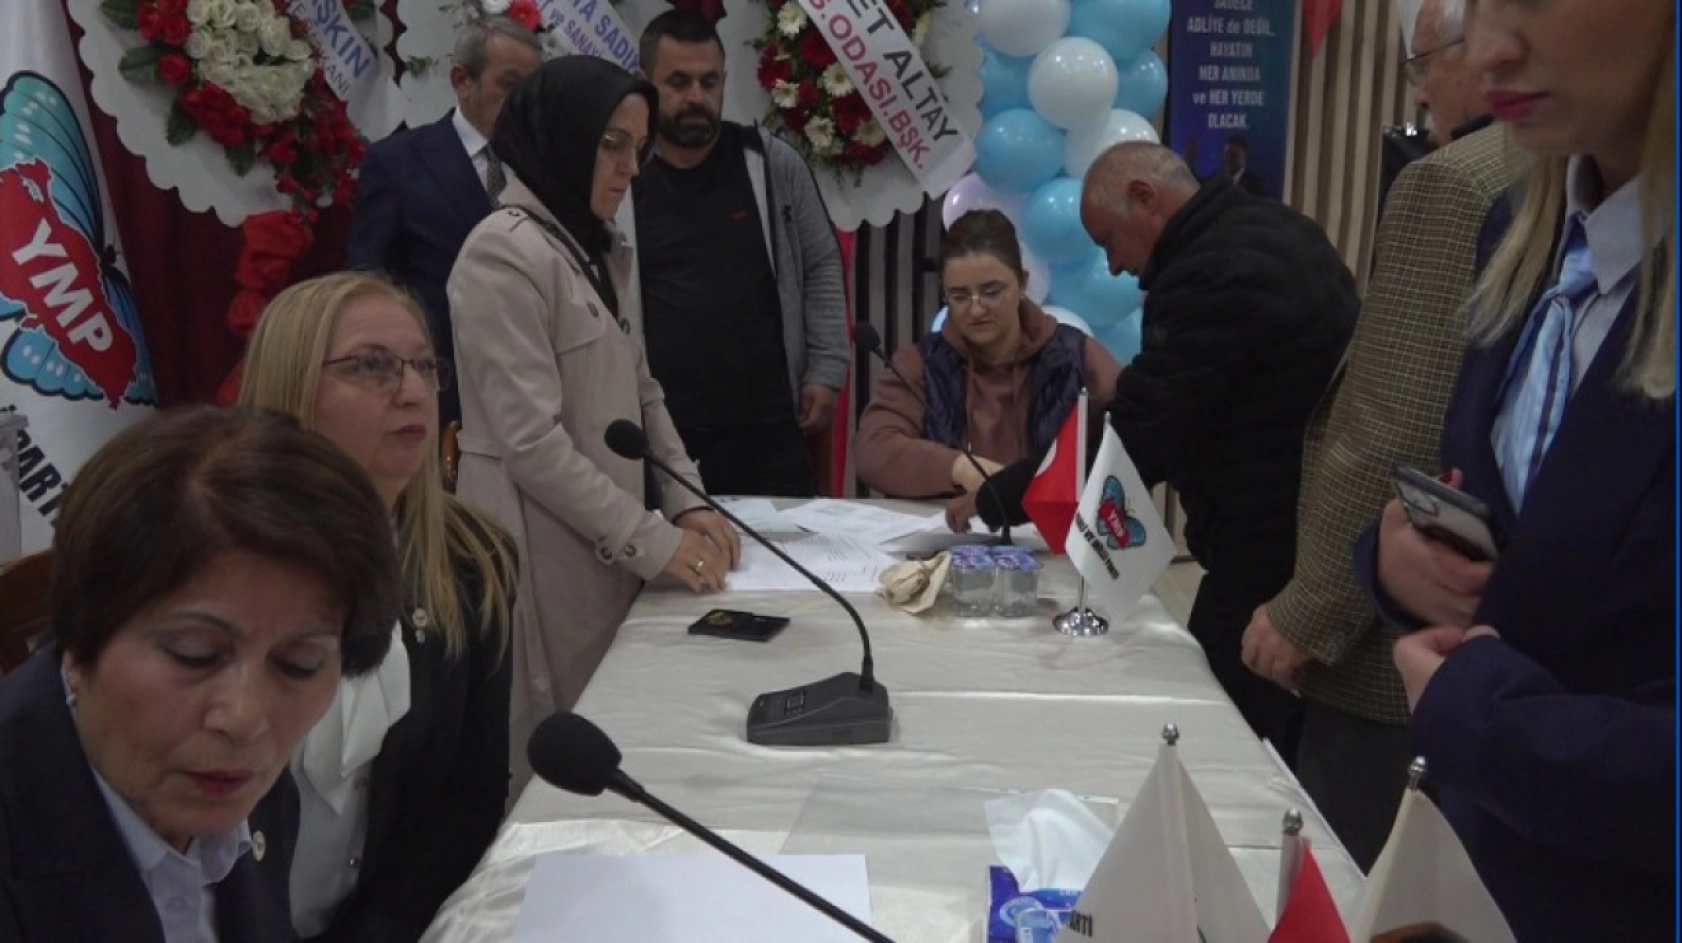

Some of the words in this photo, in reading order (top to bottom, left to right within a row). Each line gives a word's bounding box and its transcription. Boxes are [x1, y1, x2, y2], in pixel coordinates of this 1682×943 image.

[1186, 14, 1225, 33] ADLİYE
[1226, 19, 1241, 33] de
[312, 0, 371, 79] ŞKIN
[1209, 42, 1252, 57] HAYATIN
[1199, 65, 1220, 80] HER
[1222, 66, 1260, 81] ANINDA
[883, 51, 958, 141] ALTAY
[1192, 92, 1207, 104] ve
[1209, 89, 1229, 104] HER
[1231, 90, 1264, 106] YERDE
[11, 217, 114, 352] YMP
